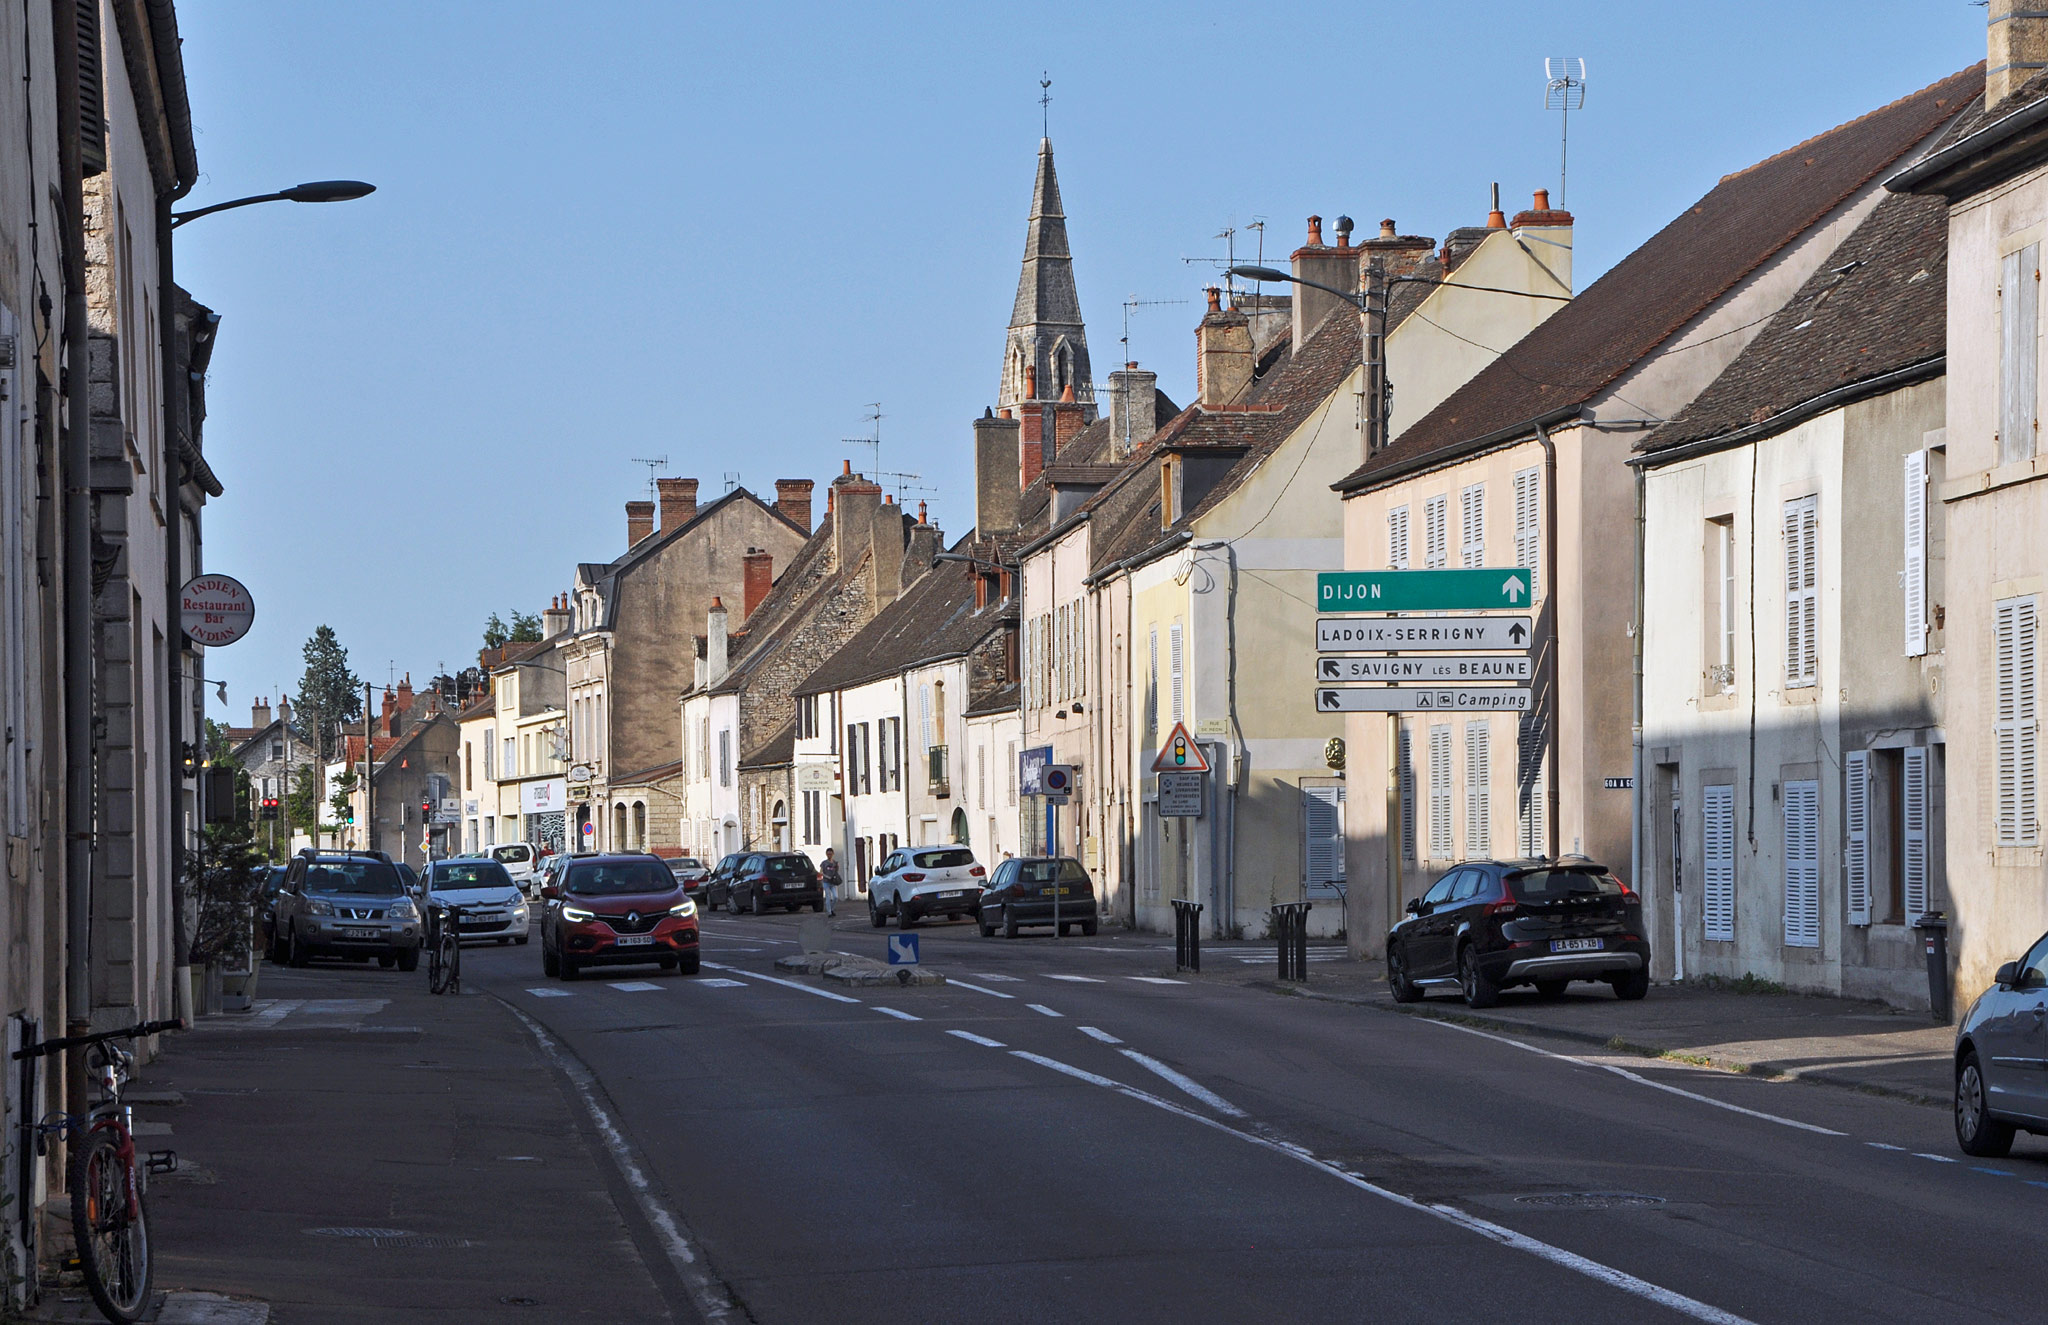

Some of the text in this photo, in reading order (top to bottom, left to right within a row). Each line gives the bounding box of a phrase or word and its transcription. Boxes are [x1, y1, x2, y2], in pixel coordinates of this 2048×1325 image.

[191, 580, 240, 598] INDIEN
[1323, 583, 1382, 600] DIJON
[183, 598, 246, 611] Restaurant
[204, 612, 225, 624] Bar
[190, 624, 236, 641] INDIAN
[1321, 627, 1486, 642] LADOIX-SERRIGNY
[1350, 662, 1527, 676] SAVIGNY LÈS BEAUNE
[1458, 692, 1527, 709] Camping
[1556, 938, 1597, 950] EA-651-XB
